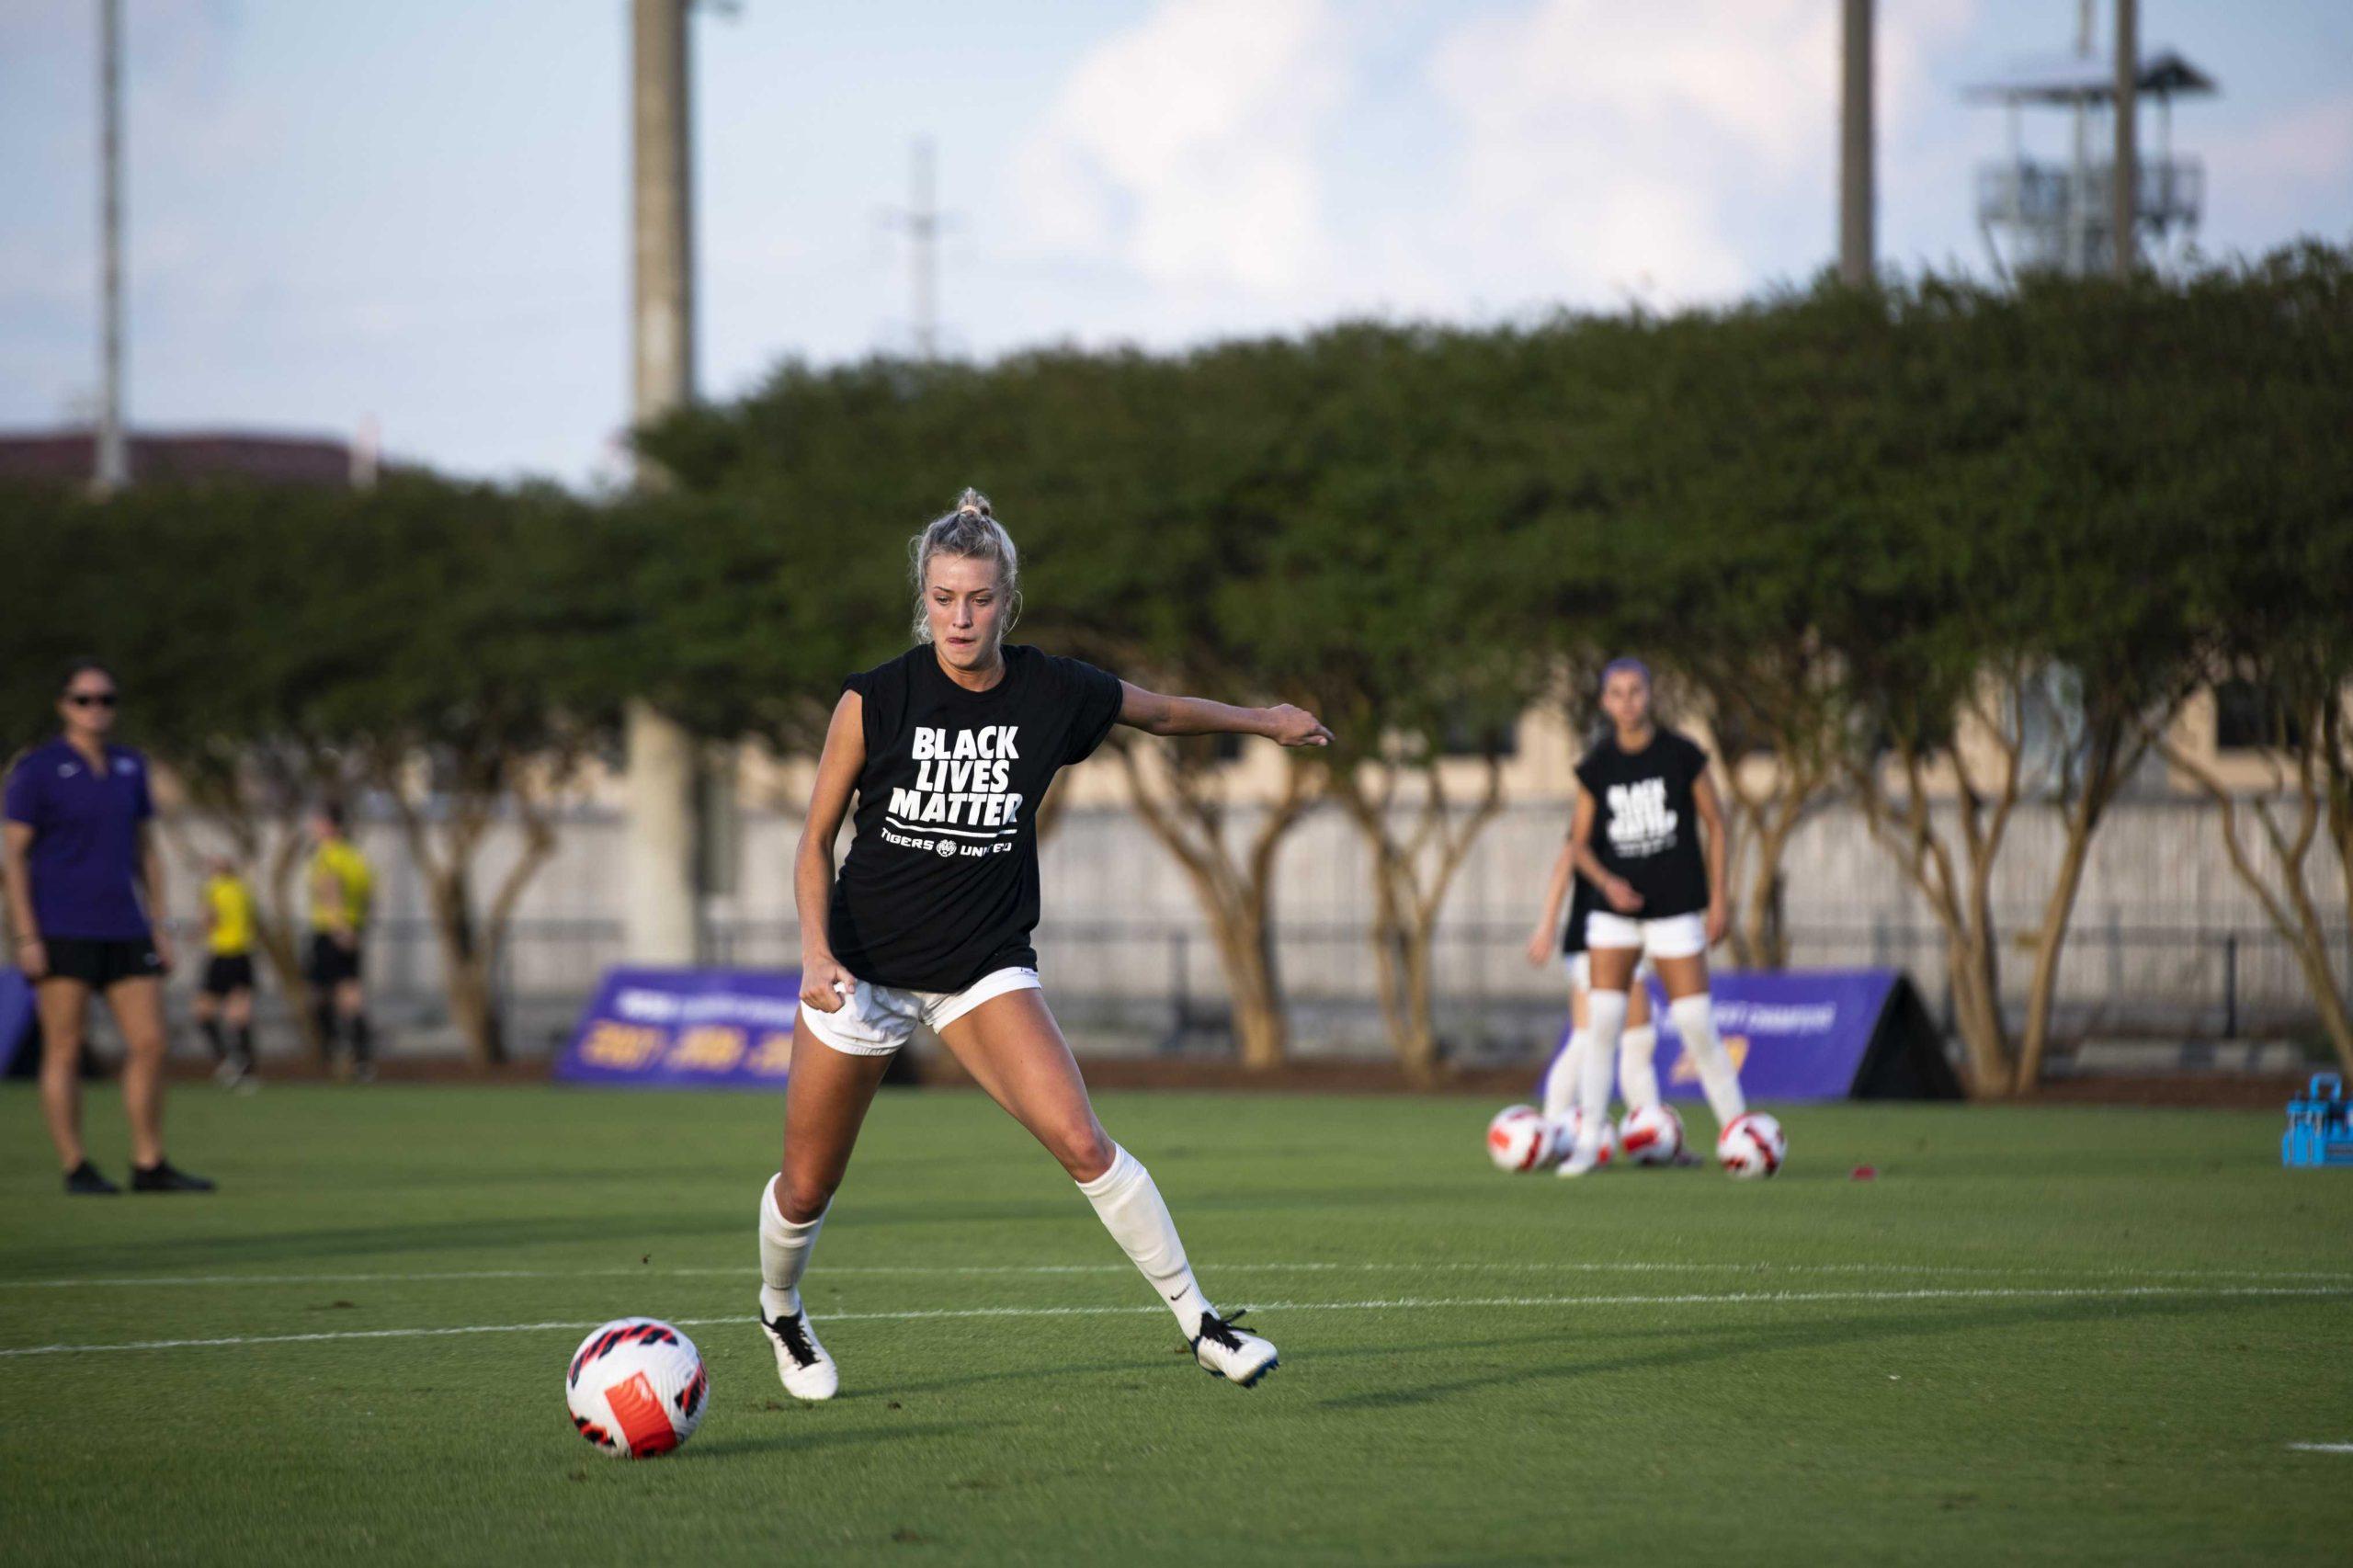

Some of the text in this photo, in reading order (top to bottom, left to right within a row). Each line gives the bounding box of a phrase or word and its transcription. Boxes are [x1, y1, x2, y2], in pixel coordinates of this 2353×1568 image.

[912, 726, 1019, 760] BLACK
[915, 759, 1010, 793] LIVES
[888, 787, 1023, 826] MATTER
[881, 827, 935, 851] TIGERS
